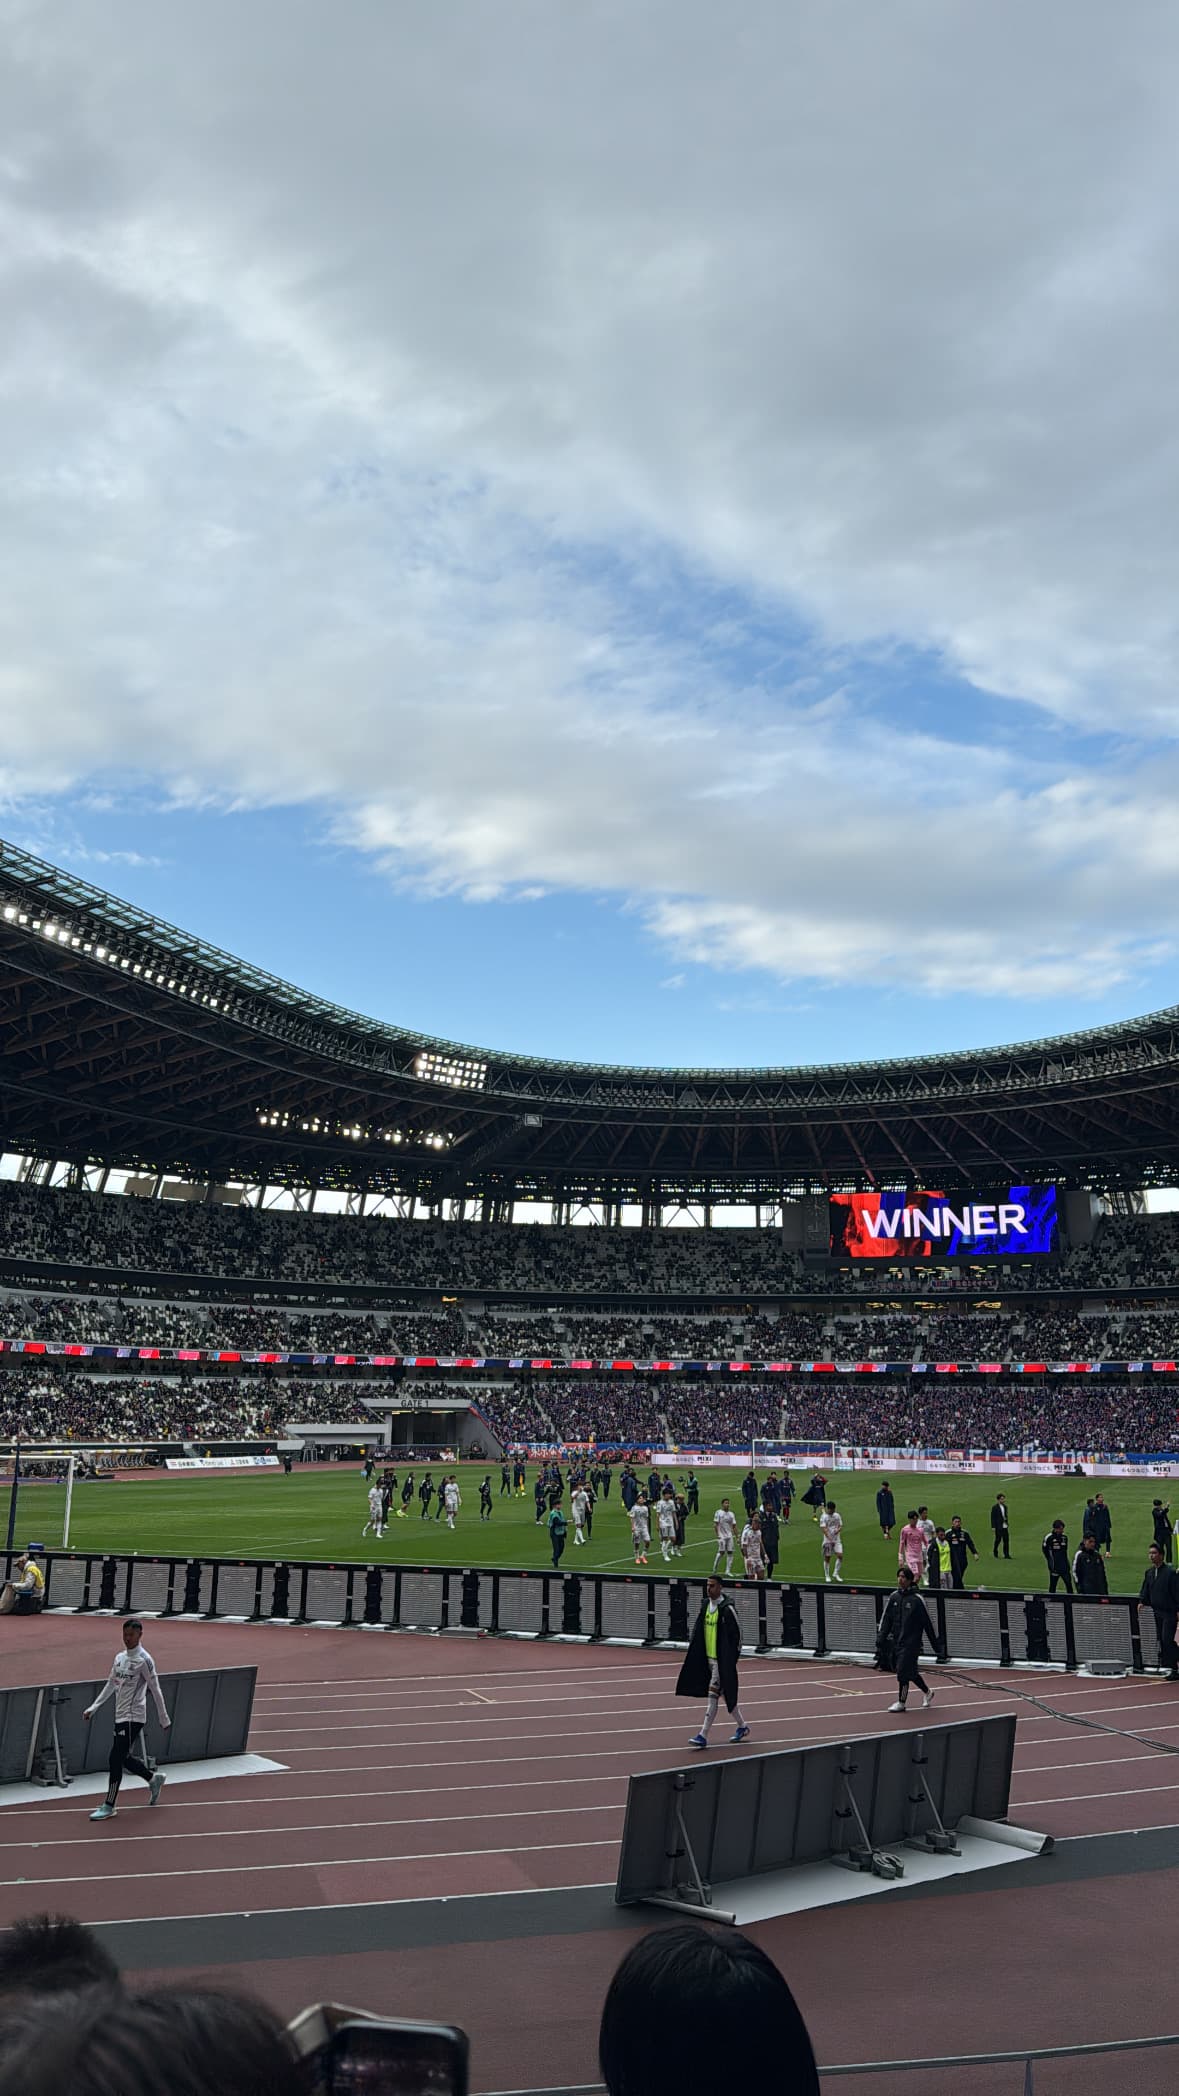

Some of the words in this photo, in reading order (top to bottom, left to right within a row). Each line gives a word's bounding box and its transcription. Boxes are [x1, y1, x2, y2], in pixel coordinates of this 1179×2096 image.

[862, 1204, 1029, 1238] WINNER
[401, 1399, 423, 1408] GATE
[425, 1399, 429, 1408] 1
